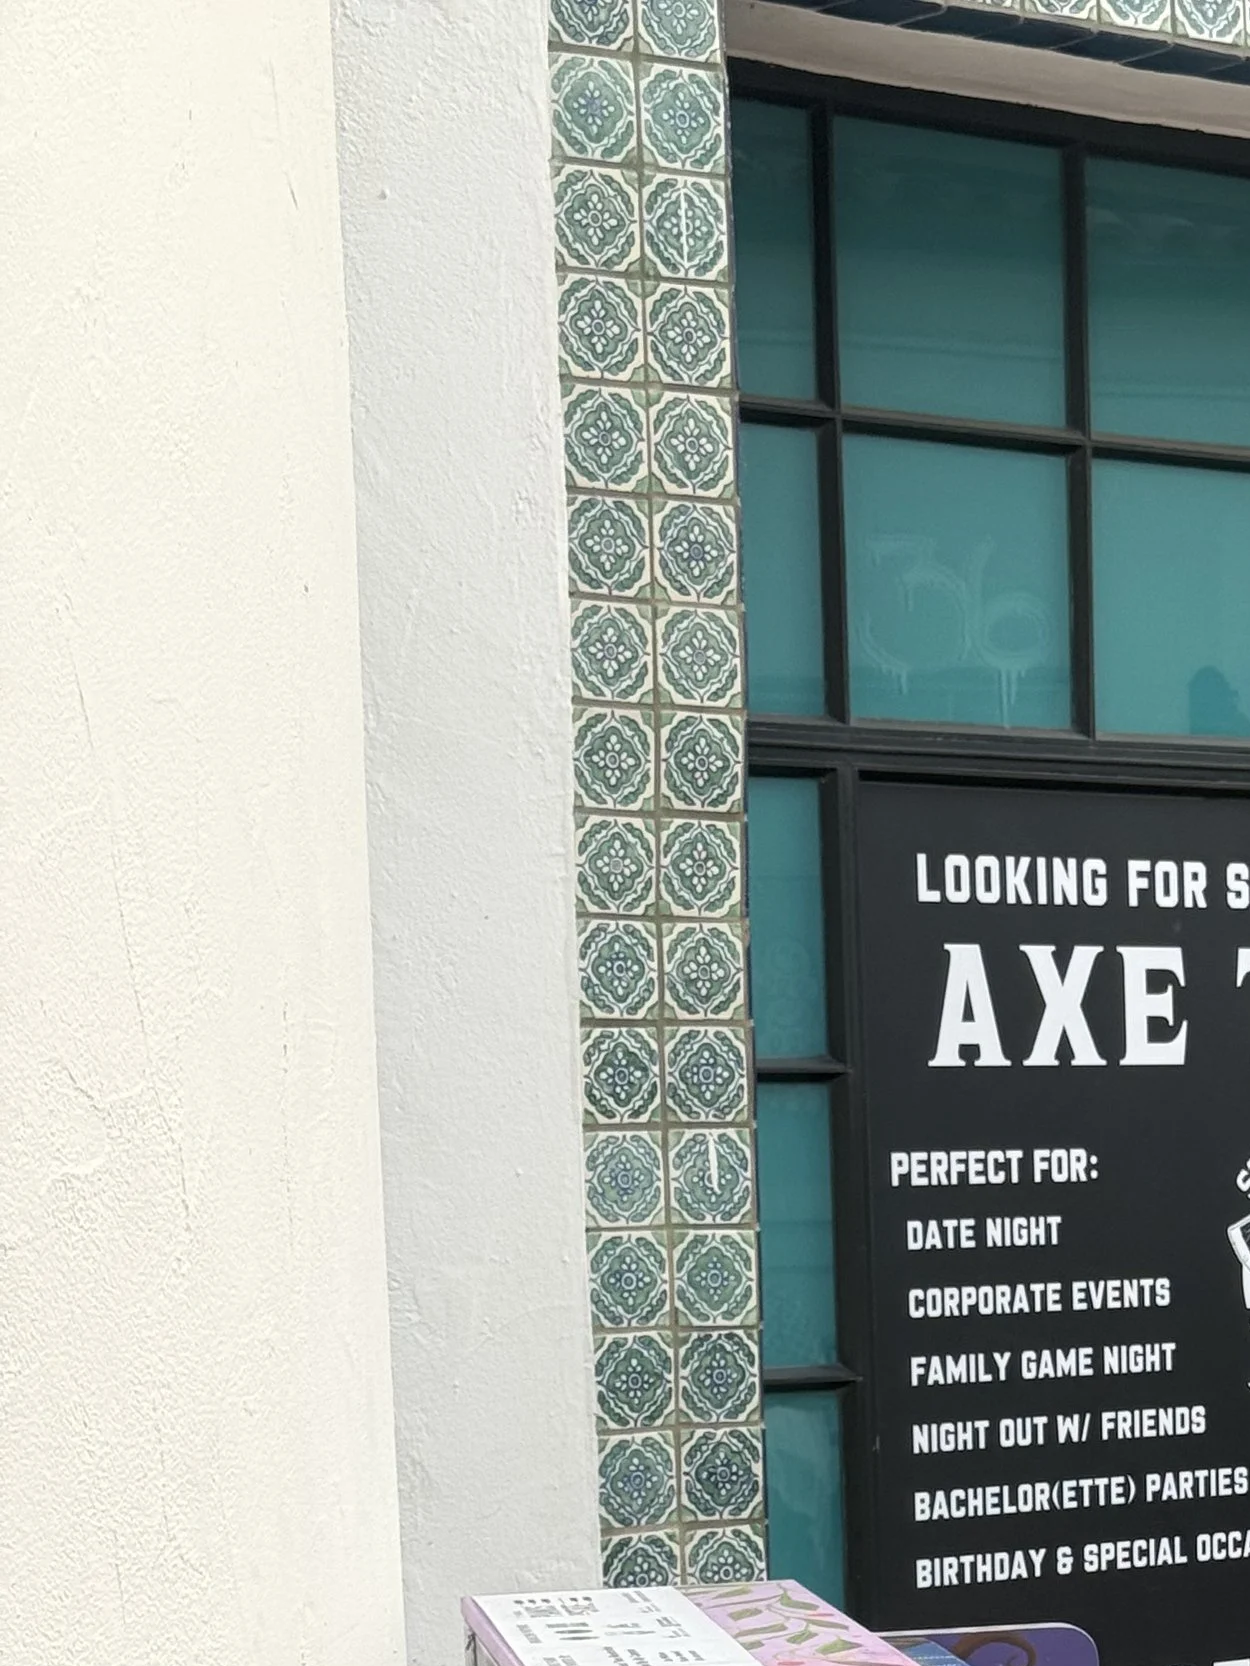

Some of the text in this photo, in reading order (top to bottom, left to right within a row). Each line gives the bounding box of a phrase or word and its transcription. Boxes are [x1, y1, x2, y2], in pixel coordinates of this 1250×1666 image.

[916, 853, 1108, 906] LOOKING
[1127, 859, 1208, 909] FOR
[927, 943, 1188, 1067] AXE
[890, 1148, 1098, 1187] PERFECT FOR:
[906, 1215, 1062, 1250] DATE NIGHT
[908, 1277, 1171, 1319] CORPORATE EVENTS
[910, 1342, 1177, 1387] FAMILY GAME NIGHT
[912, 1405, 1206, 1454] NIGHT OUT W/ FRIENDS
[914, 1466, 1249, 1522] BACHELOR(ETTE) PARTIES
[915, 1548, 1047, 1589] BIRTHDAY
[1056, 1545, 1074, 1575] &
[1083, 1535, 1188, 1573] SPECIAL
